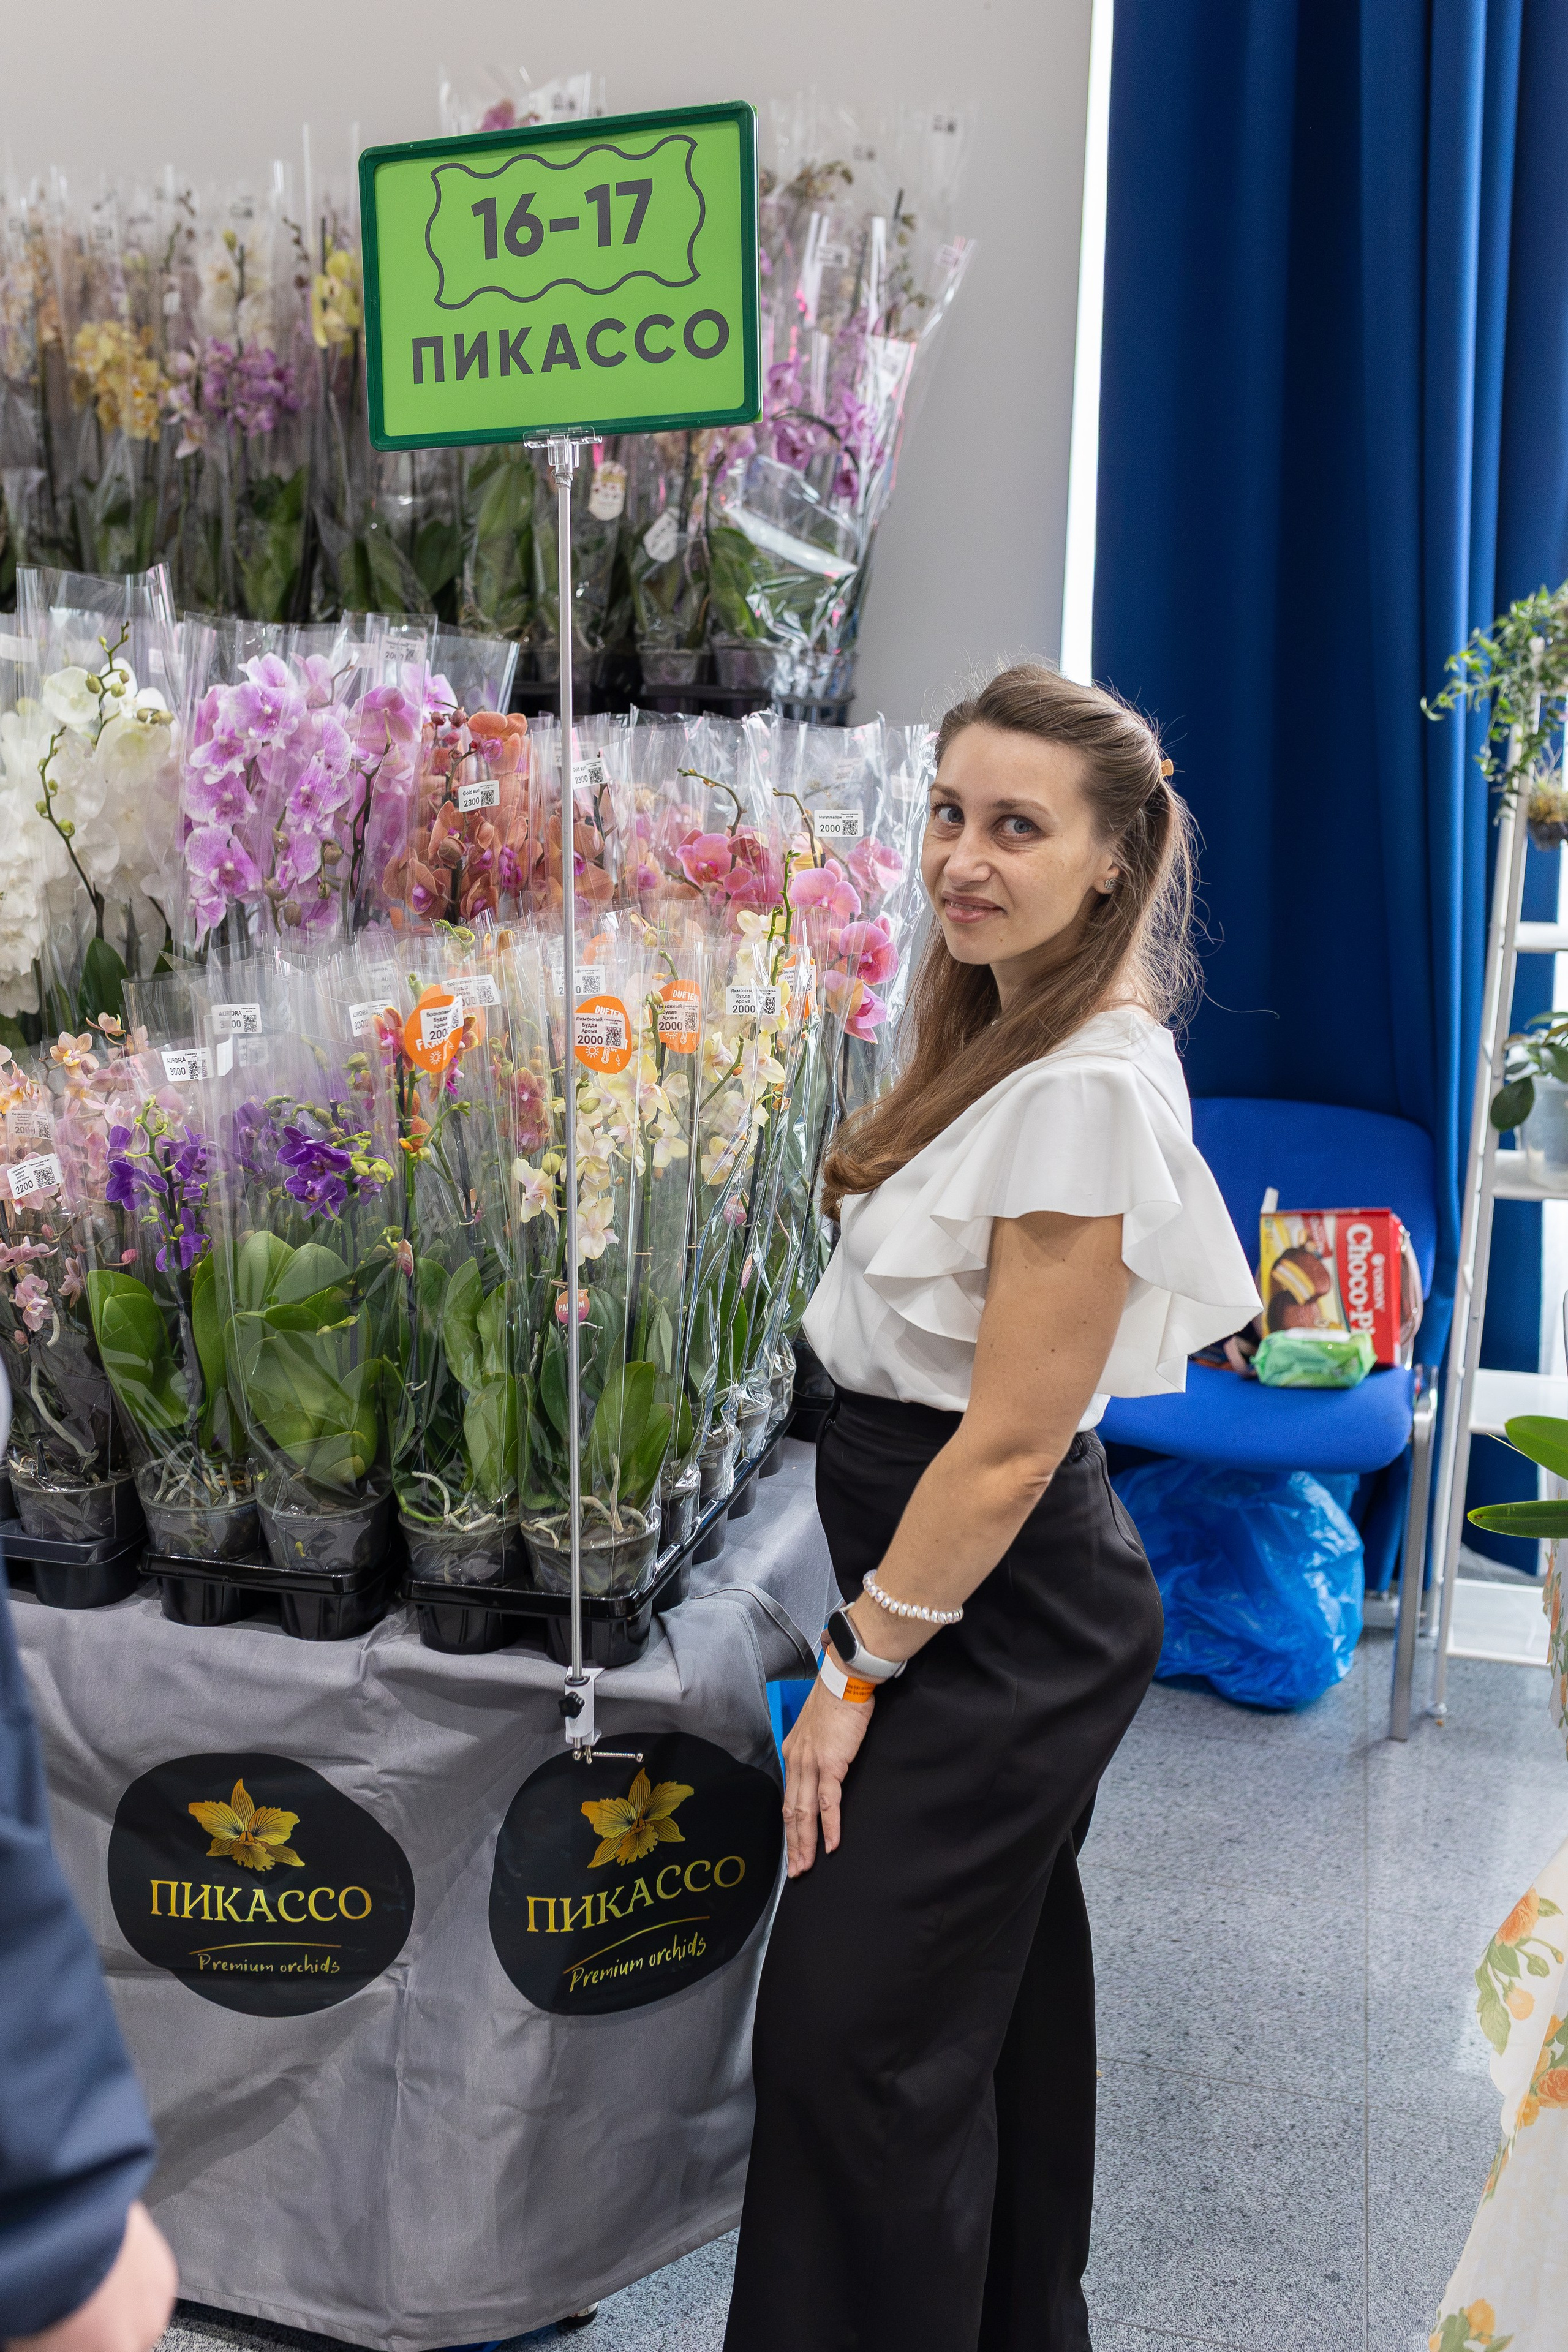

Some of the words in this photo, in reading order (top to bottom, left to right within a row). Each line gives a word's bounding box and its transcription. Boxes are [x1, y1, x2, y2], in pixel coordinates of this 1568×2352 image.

[470, 178, 653, 260] 16-17
[412, 309, 729, 384] ПИКАССО
[575, 775, 588, 784] 2300
[464, 797, 480, 807] 2300
[558, 986, 581, 995] 20
[732, 1005, 756, 1014] 2000
[220, 1020, 241, 1028] 300
[658, 1022, 683, 1031] 2000
[429, 1027, 450, 1040] 200
[577, 1035, 603, 1045] 2000
[169, 1066, 186, 1076] 3000
[15, 1180, 34, 1195] 2200
[526, 1855, 746, 1933] ПИКАССО
[149, 1879, 372, 1923] ПИКАССО
[197, 1953, 274, 1972] Premium
[279, 1953, 341, 1973] orchids
[569, 1958, 643, 1992] Premium
[649, 1931, 706, 1967] orchids
